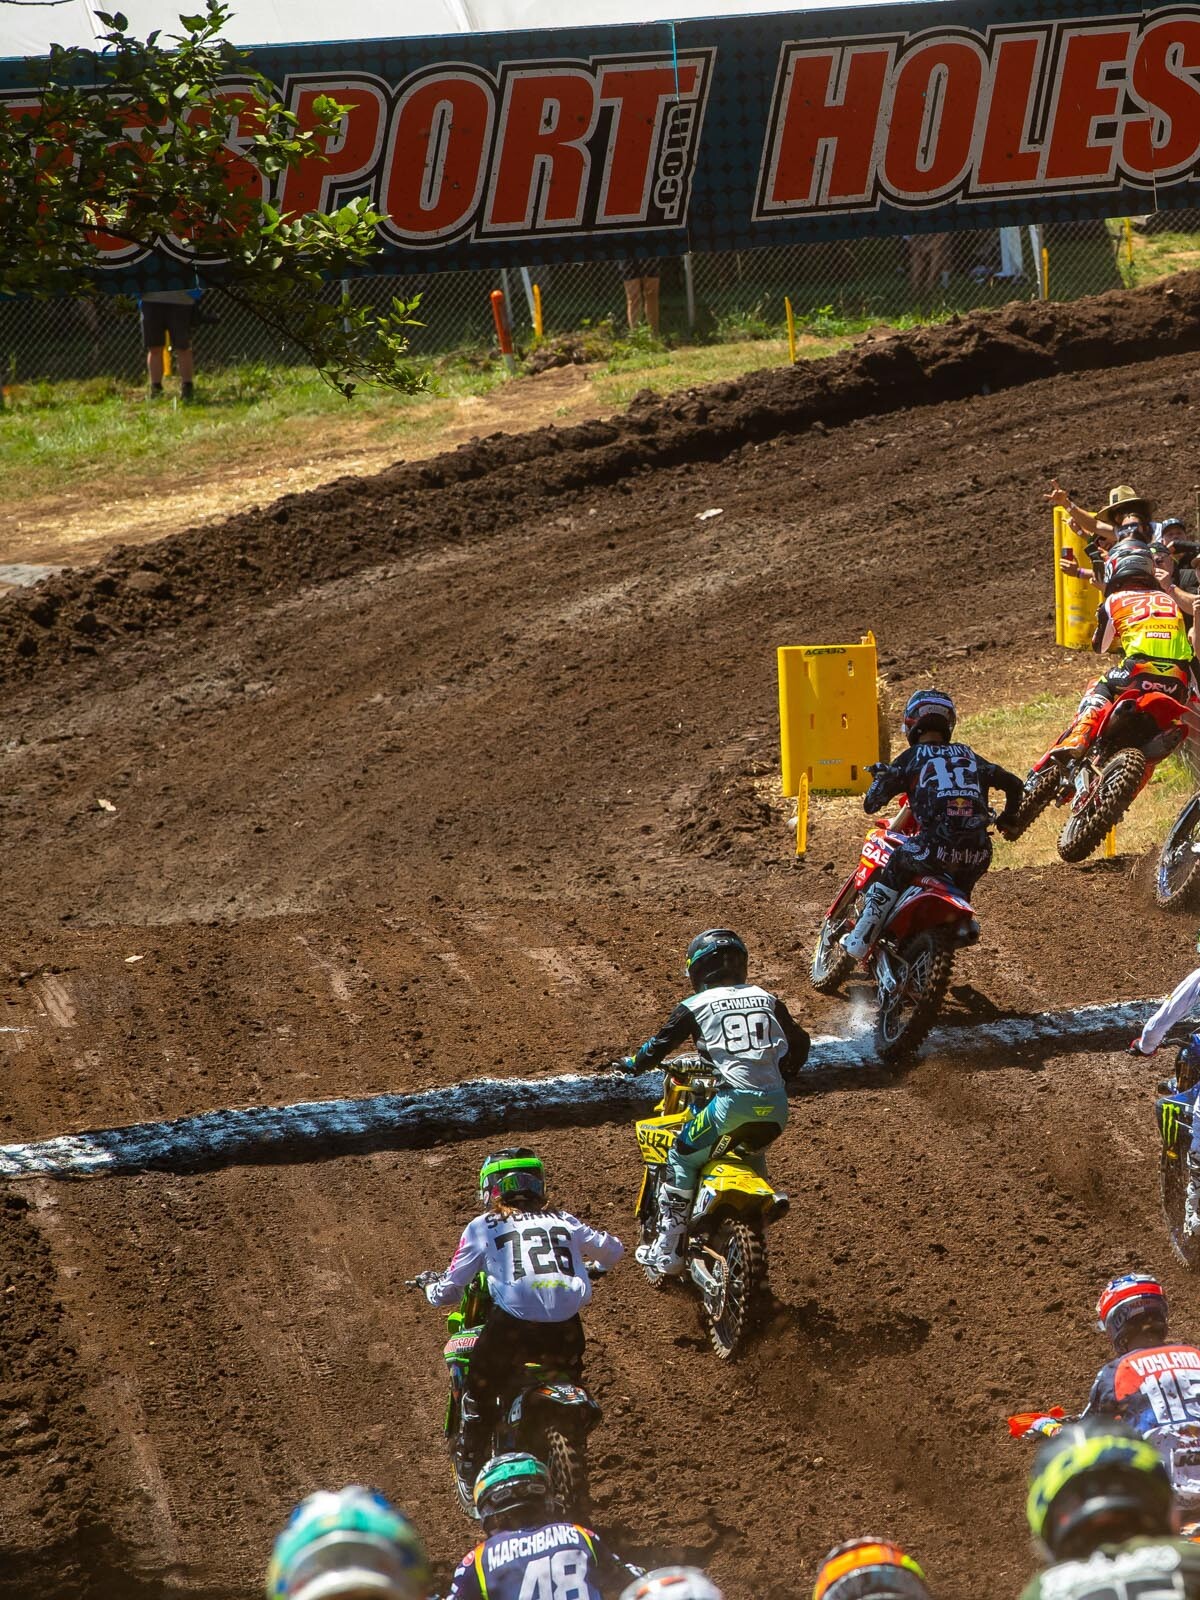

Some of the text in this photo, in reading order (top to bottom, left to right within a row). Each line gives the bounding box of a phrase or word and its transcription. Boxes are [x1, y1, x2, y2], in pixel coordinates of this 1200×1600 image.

[1121, 594, 1179, 626] 39
[919, 757, 980, 792] 42
[711, 996, 769, 1014] SCHWARTZ
[721, 1011, 773, 1054] 90
[638, 1130, 677, 1147] SUZU
[494, 1226, 576, 1280] 726
[487, 1524, 580, 1573] MARCHBANKS
[517, 1550, 591, 1600] 48
